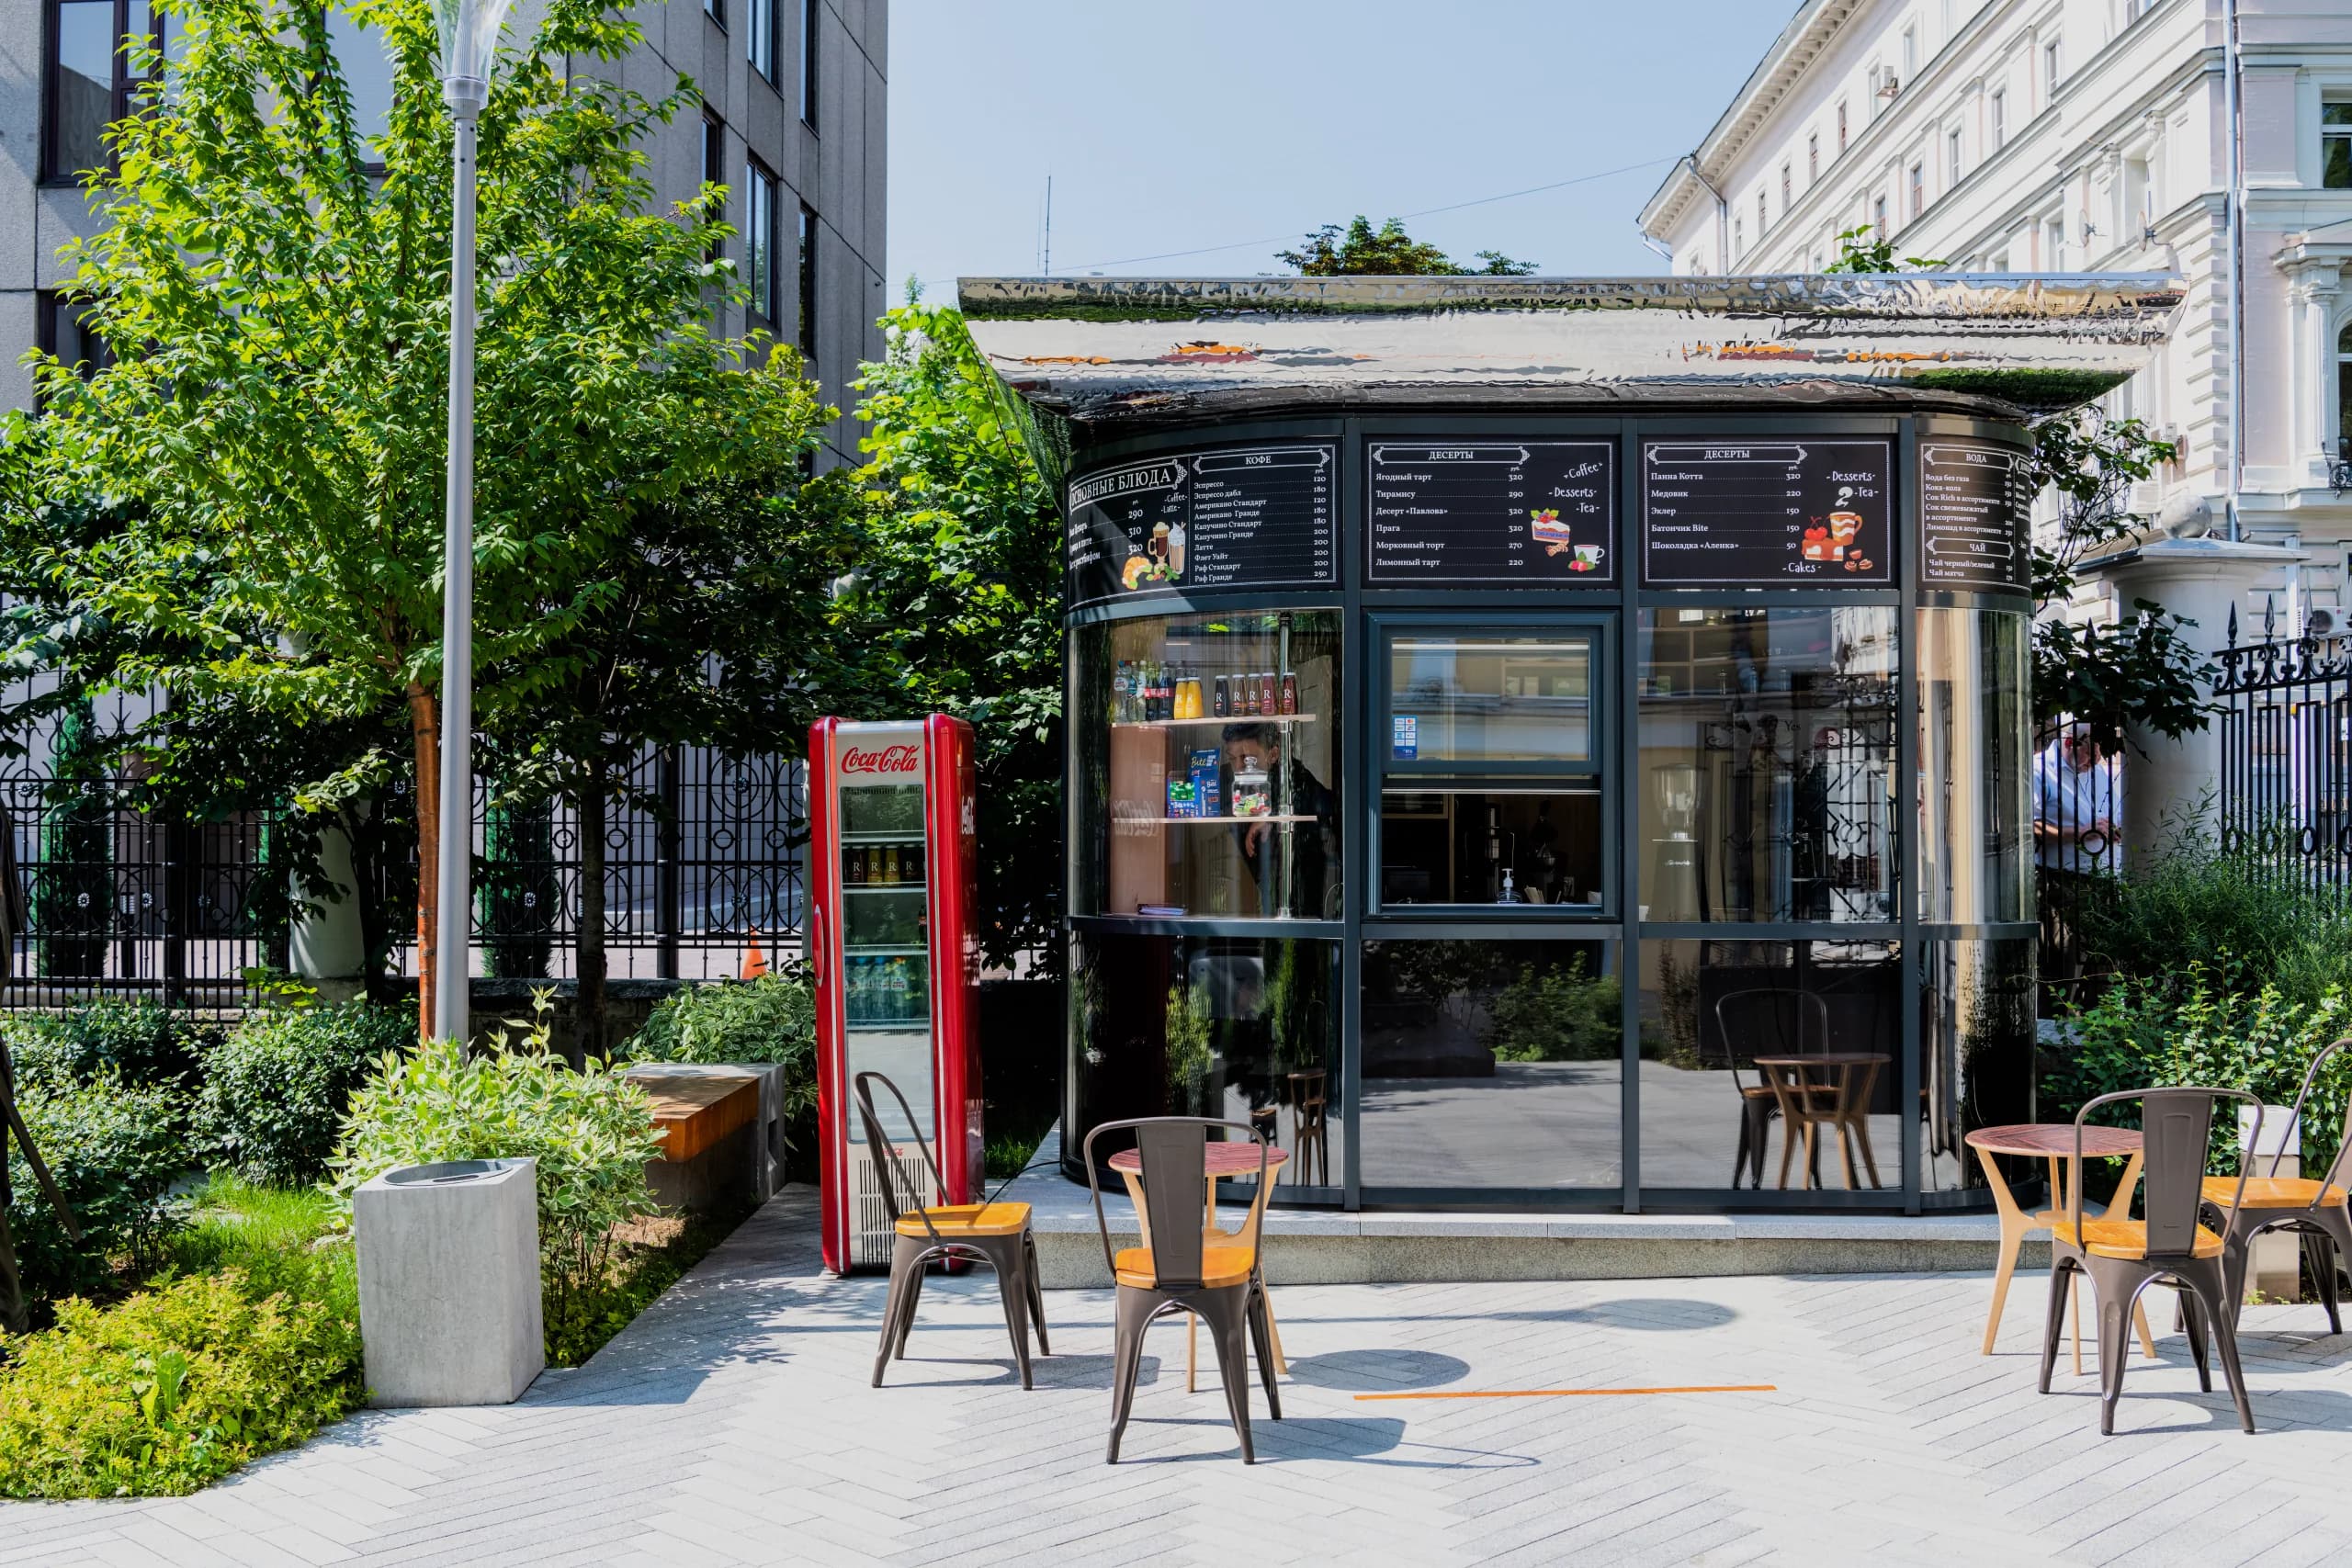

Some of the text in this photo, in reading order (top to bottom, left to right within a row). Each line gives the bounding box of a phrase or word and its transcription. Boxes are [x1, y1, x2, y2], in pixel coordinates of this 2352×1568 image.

[1429, 451, 1474, 460] ДЕСЕРТЫ
[1704, 450, 1750, 459] ДЕСЕРТЫ
[1965, 453, 1987, 463] ВОДА
[1245, 456, 1272, 465] КОФЕ
[1118, 468, 1170, 491] БЛЮДА
[1375, 473, 1413, 481] Ягодный
[1651, 472, 1678, 480] Панна
[1679, 472, 1703, 480] Котта
[1925, 474, 1943, 482] Вода
[1193, 481, 1225, 491] Эспрессо
[1925, 483, 1962, 491] Кока-кола
[1193, 491, 1225, 500] Эспрессо
[1375, 490, 1416, 499] Тирамису
[1651, 490, 1689, 498] Медовик
[1940, 493, 1956, 502] Rich
[1962, 497, 2000, 505] ассортименте
[1193, 501, 1233, 511] Американо
[1233, 499, 1268, 507] Стандарт
[1940, 505, 1989, 513] свежевыжатый
[1128, 509, 1144, 520] 290
[1193, 512, 1233, 522] Американо
[1235, 510, 1261, 519] Гранде
[1375, 507, 1405, 516] Десерт
[1651, 507, 1677, 516] Эклер
[1194, 522, 1228, 532] Капучино
[1228, 520, 1262, 528] Стандарт
[1375, 525, 1401, 534] Прага
[1926, 524, 1958, 533] Лимонад
[1128, 526, 1142, 538] 310
[1194, 533, 1228, 542] Капучино
[1228, 531, 1254, 539] Гранде
[1128, 544, 1143, 555] 320
[1375, 541, 1425, 550] Морковный
[1969, 543, 1985, 552] ЧАЙ
[1194, 565, 1208, 573] Раф
[1208, 563, 1241, 571] Стандарт
[1194, 575, 1208, 583] Раф
[841, 745, 921, 773] Coca-Cola
